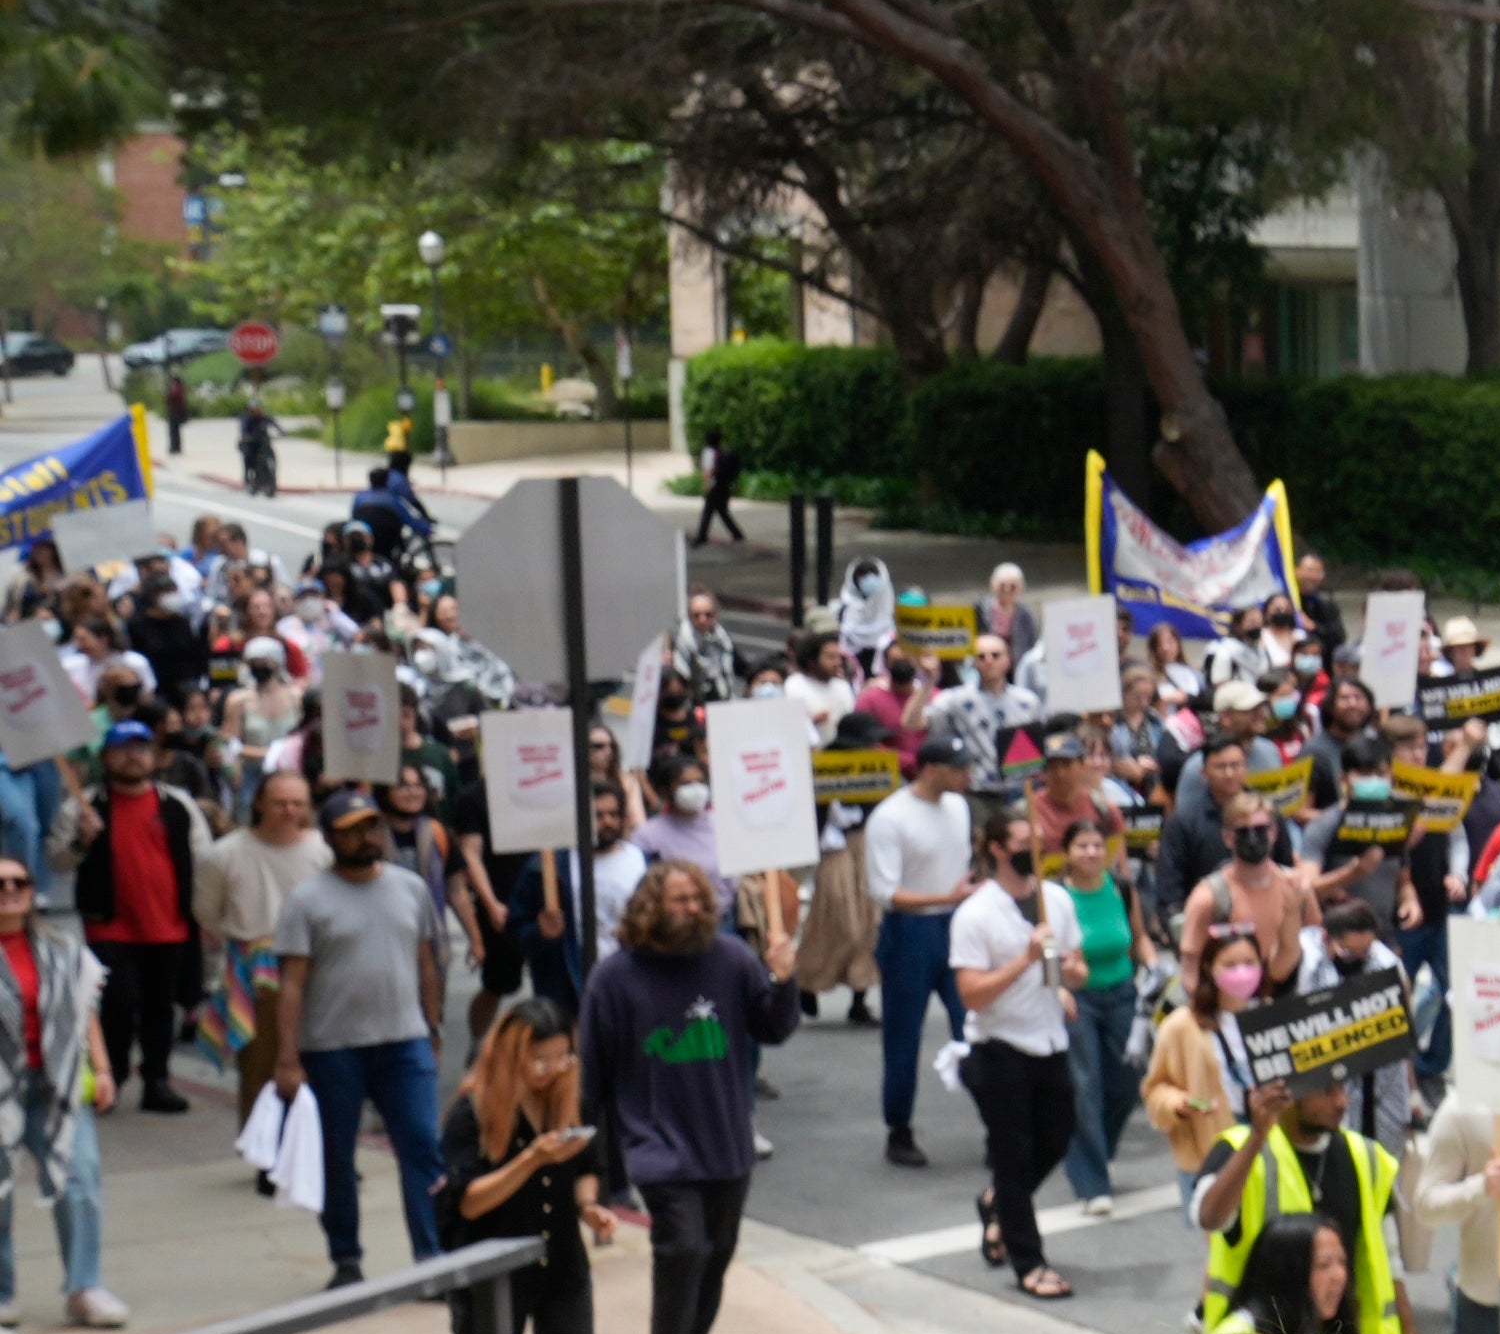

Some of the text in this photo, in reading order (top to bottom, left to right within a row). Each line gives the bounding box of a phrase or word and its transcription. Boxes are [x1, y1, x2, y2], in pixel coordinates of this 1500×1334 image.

[234, 337, 277, 351] STOP
[1245, 985, 1402, 1057] WE WILL NOT
[1253, 1012, 1406, 1083] BE SILENCED
